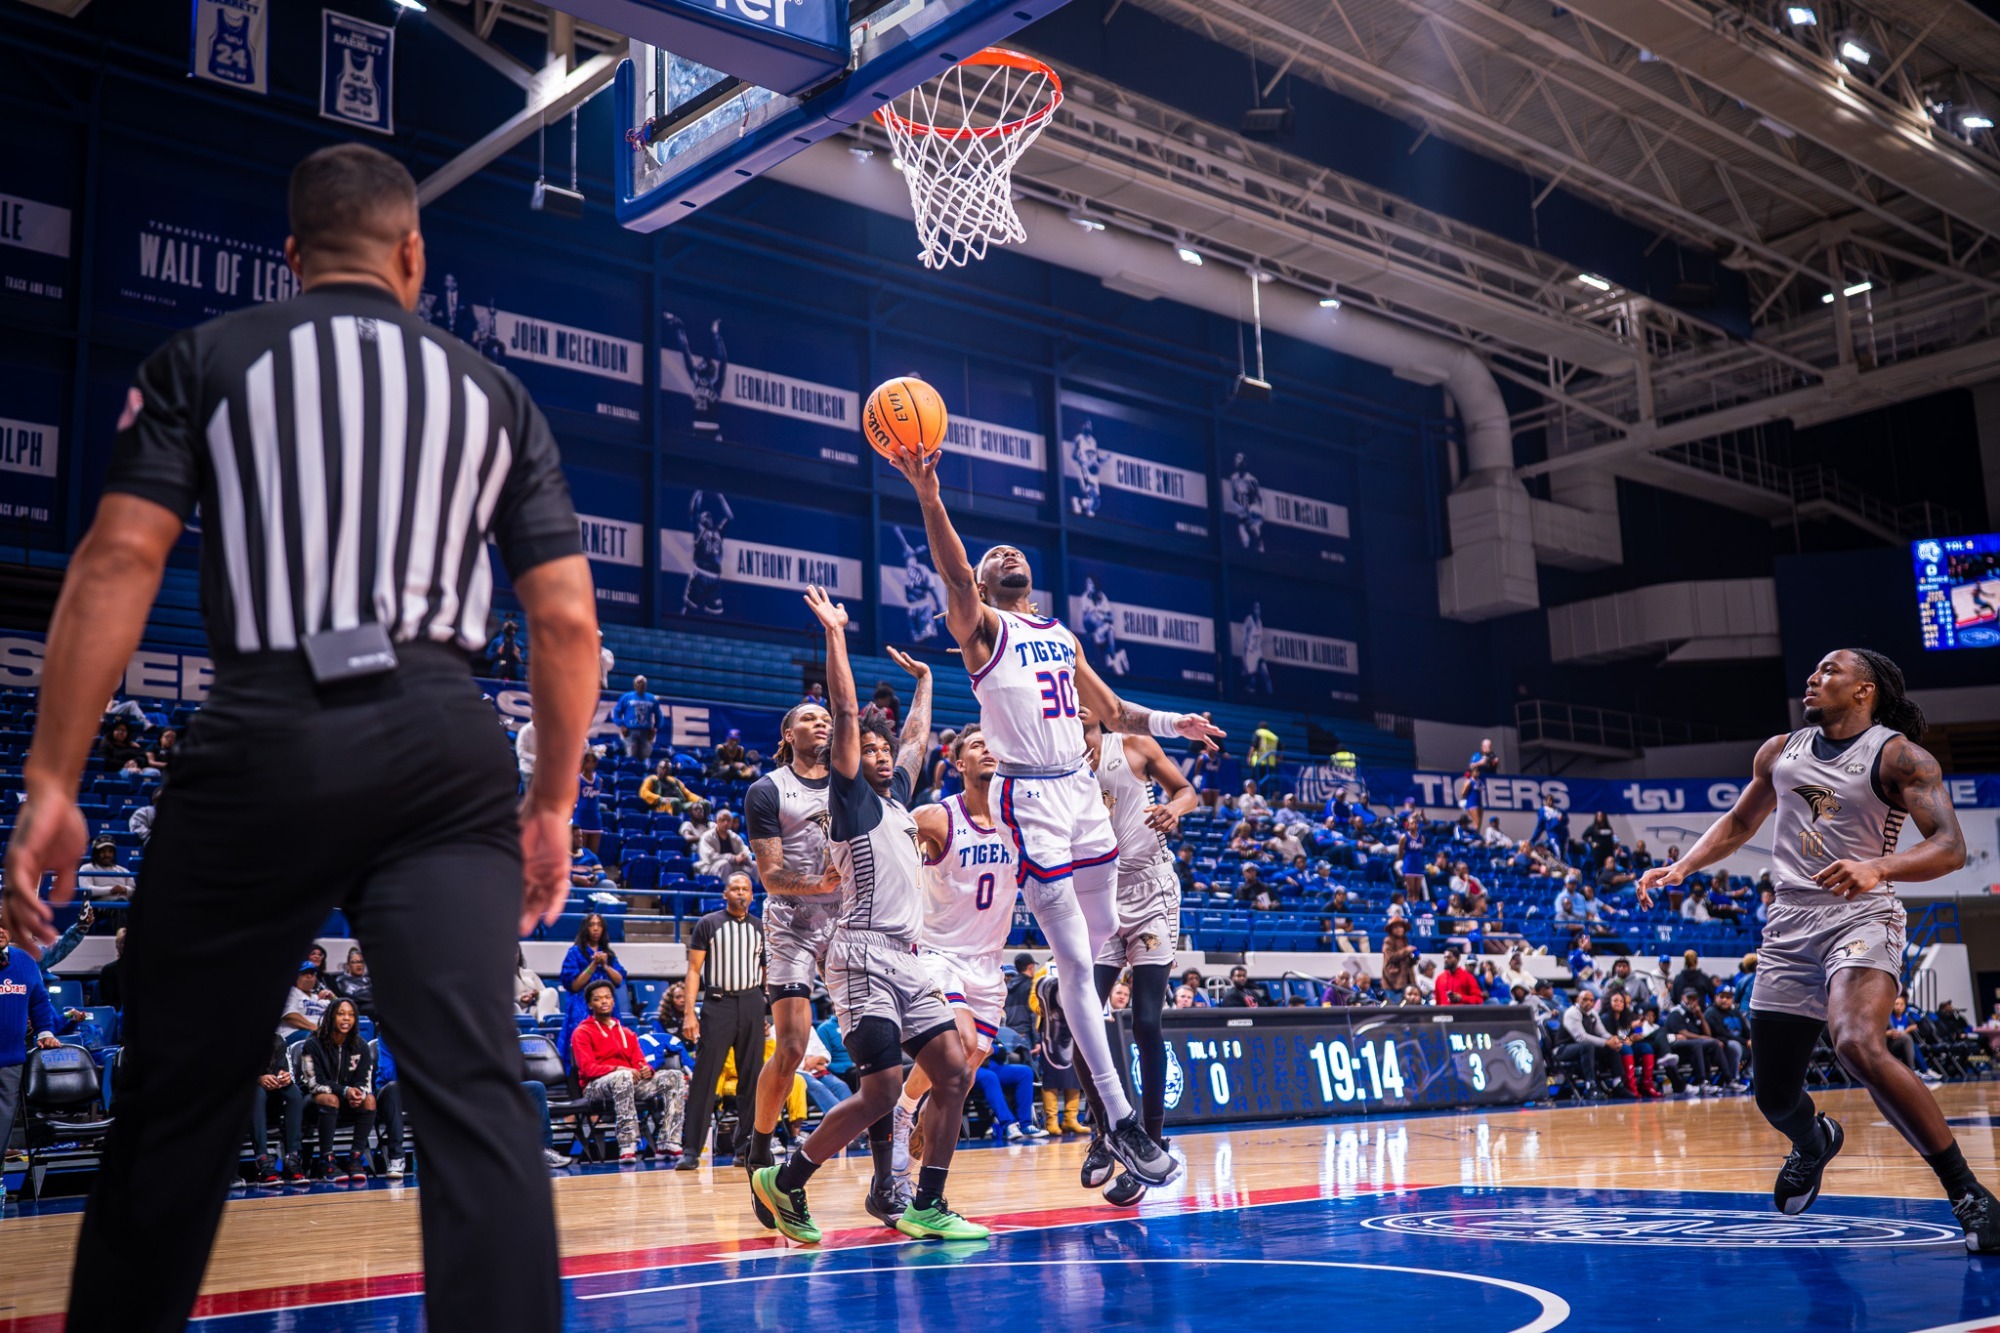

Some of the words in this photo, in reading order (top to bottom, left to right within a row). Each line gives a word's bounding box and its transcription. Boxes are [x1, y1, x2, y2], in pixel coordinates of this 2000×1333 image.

[216, 43, 248, 70] 24
[343, 82, 373, 106] 35
[140, 231, 203, 288] WALL
[215, 250, 242, 296] OF
[511, 320, 549, 356] JOHN
[555, 329, 629, 374] MCLENDON
[735, 373, 786, 408] LEONARD
[791, 385, 846, 421] ROBINSON
[944, 421, 977, 449] OBERT
[980, 428, 1032, 461] COVINGTON
[1156, 467, 1185, 499] SWIFT
[737, 548, 792, 582] ANTHONY
[798, 556, 839, 588] MASON
[1123, 610, 1159, 638] SHARON
[1163, 616, 1200, 645] JARRETT
[1035, 669, 1077, 719] 30
[1623, 783, 1685, 811] tsu
[1798, 830, 1825, 858] 10
[976, 872, 995, 911] 0
[1015, 913, 1031, 926] P-1
[1222, 1040, 1230, 1058] F
[1210, 1062, 1230, 1105] 0
[1310, 1040, 1405, 1102] 19:14
[1469, 1053, 1486, 1091] 3
